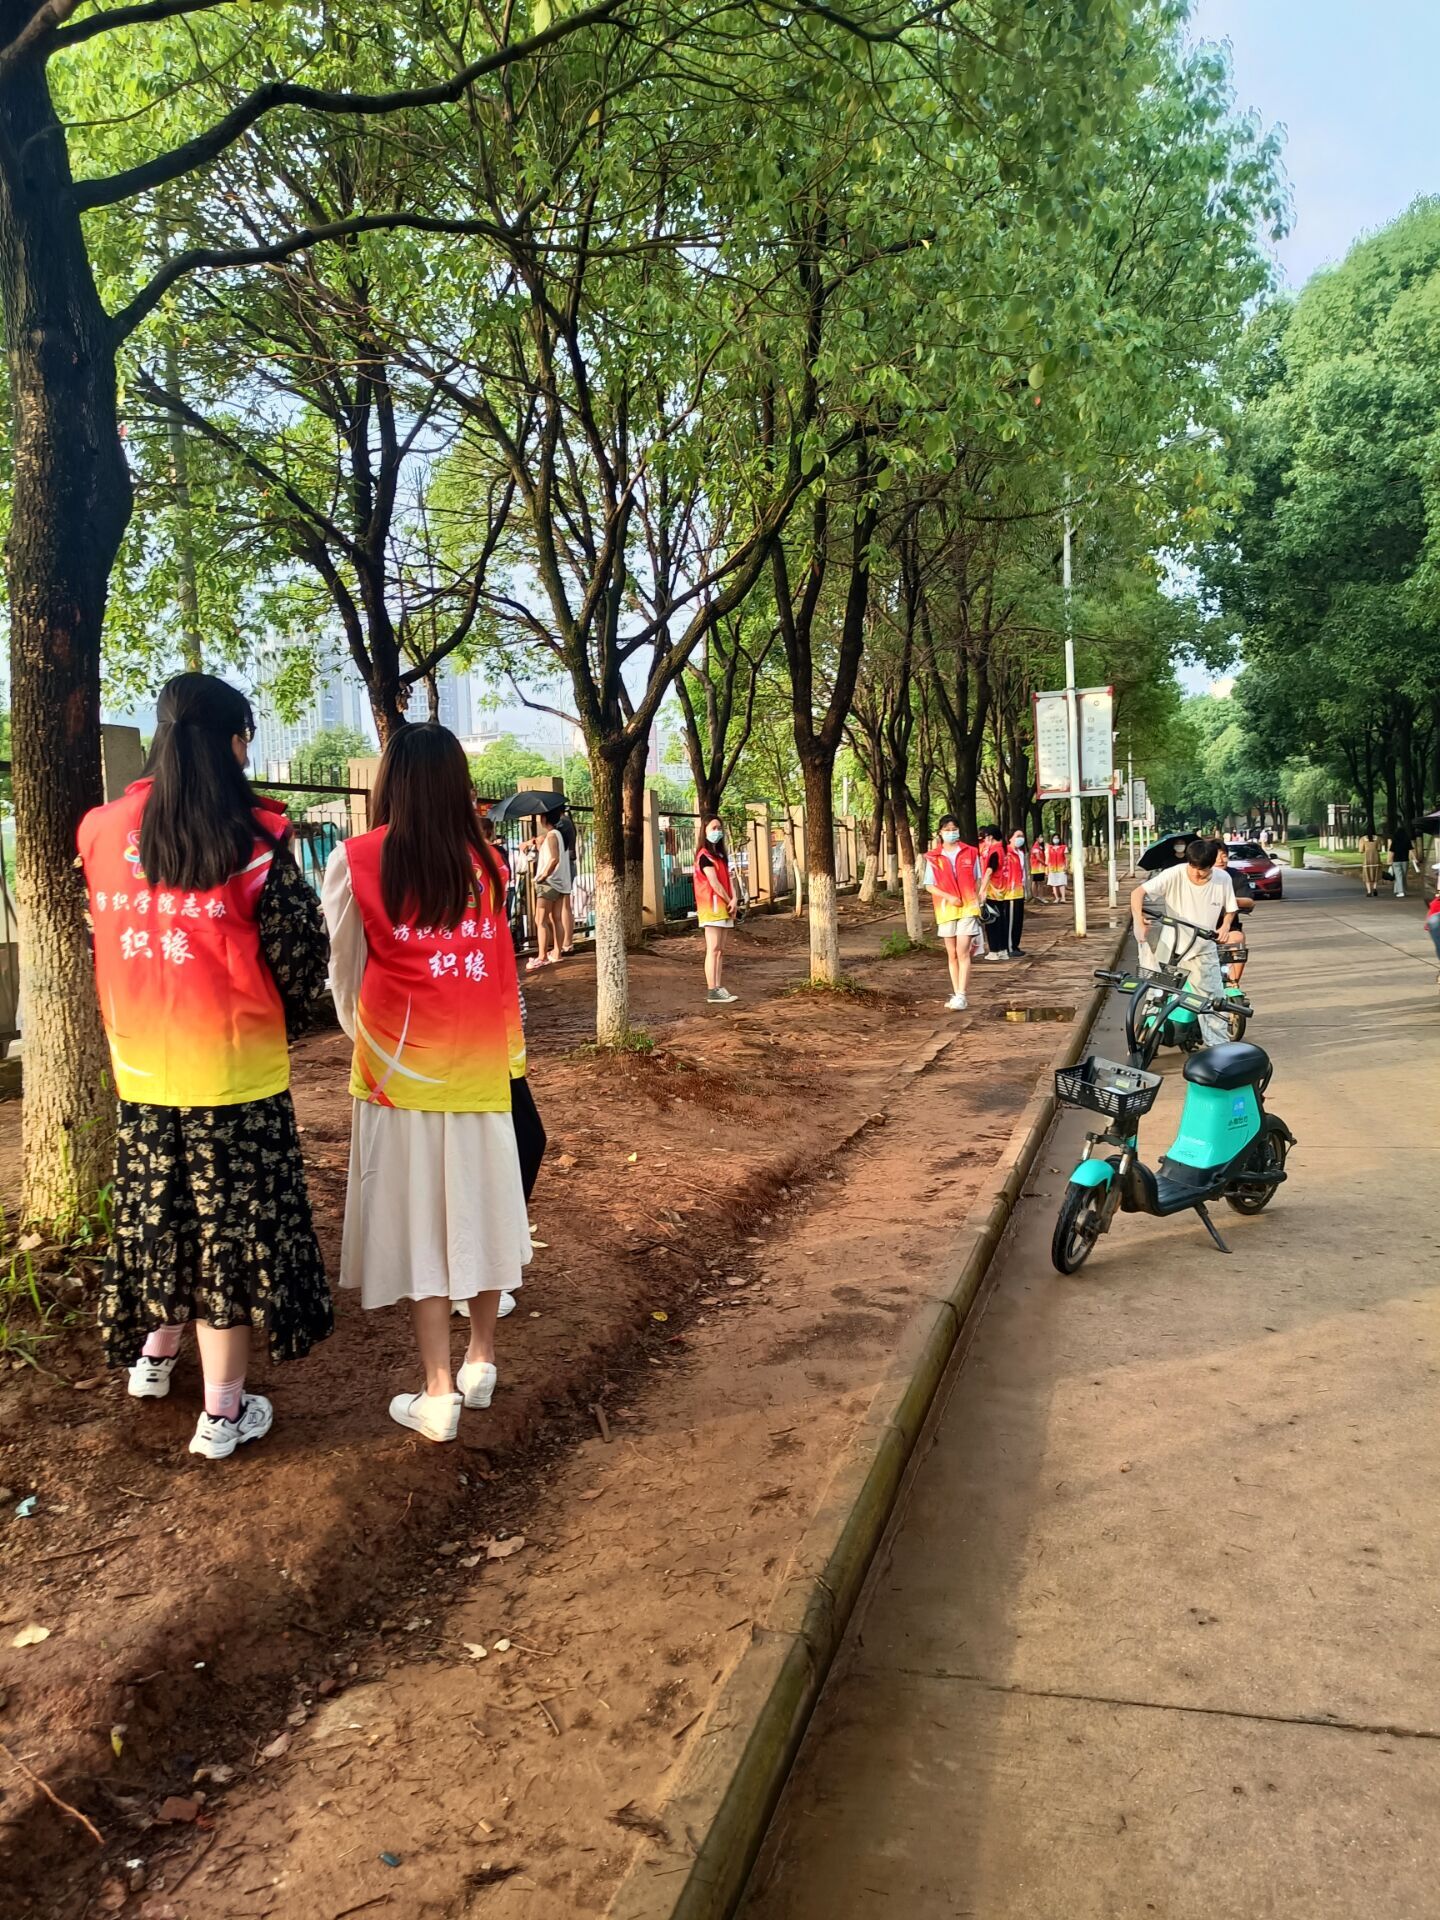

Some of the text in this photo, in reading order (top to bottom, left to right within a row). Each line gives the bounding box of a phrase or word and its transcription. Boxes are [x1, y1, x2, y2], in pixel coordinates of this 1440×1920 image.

[120, 927, 195, 965] 织缘
[393, 918, 497, 942] 纺织学院志
[428, 949, 489, 982] 织缘
